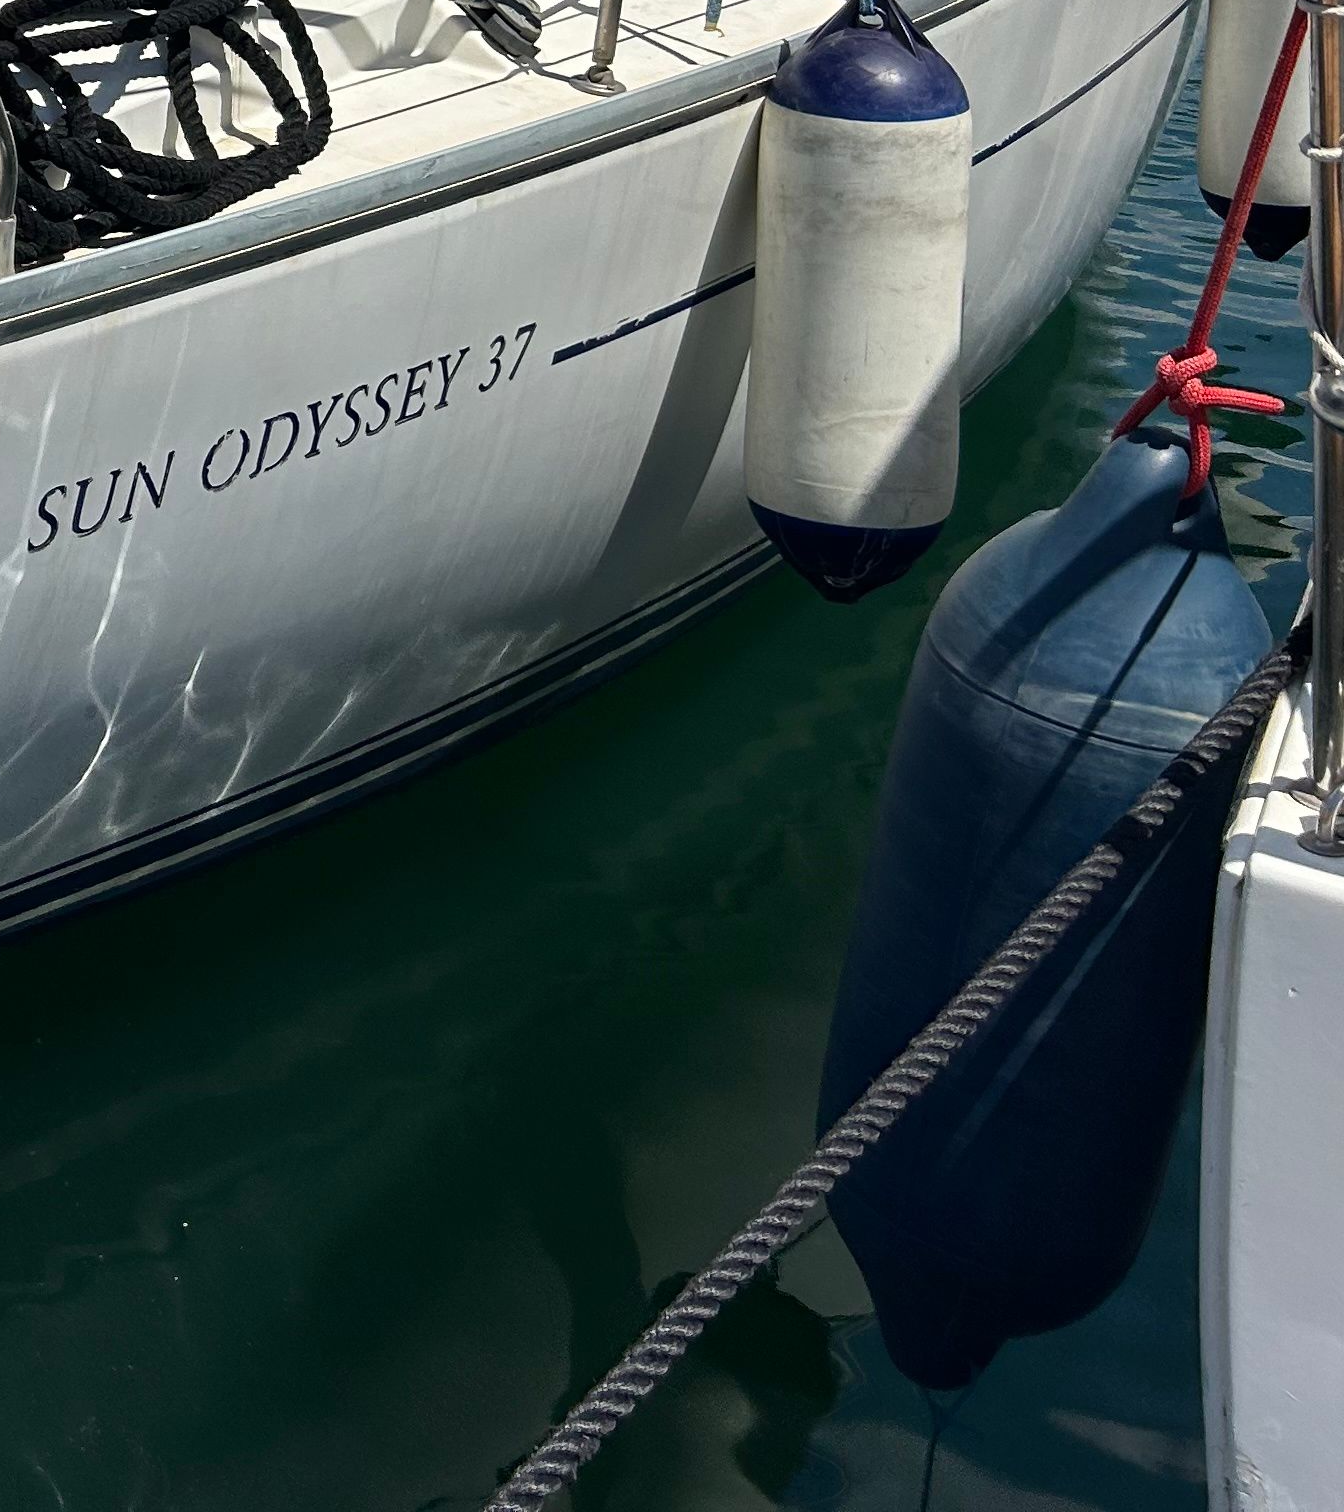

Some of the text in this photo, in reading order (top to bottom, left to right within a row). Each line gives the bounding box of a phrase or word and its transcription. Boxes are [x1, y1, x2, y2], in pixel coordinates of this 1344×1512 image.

[27, 322, 538, 553] SUN ODYSSEY 37
